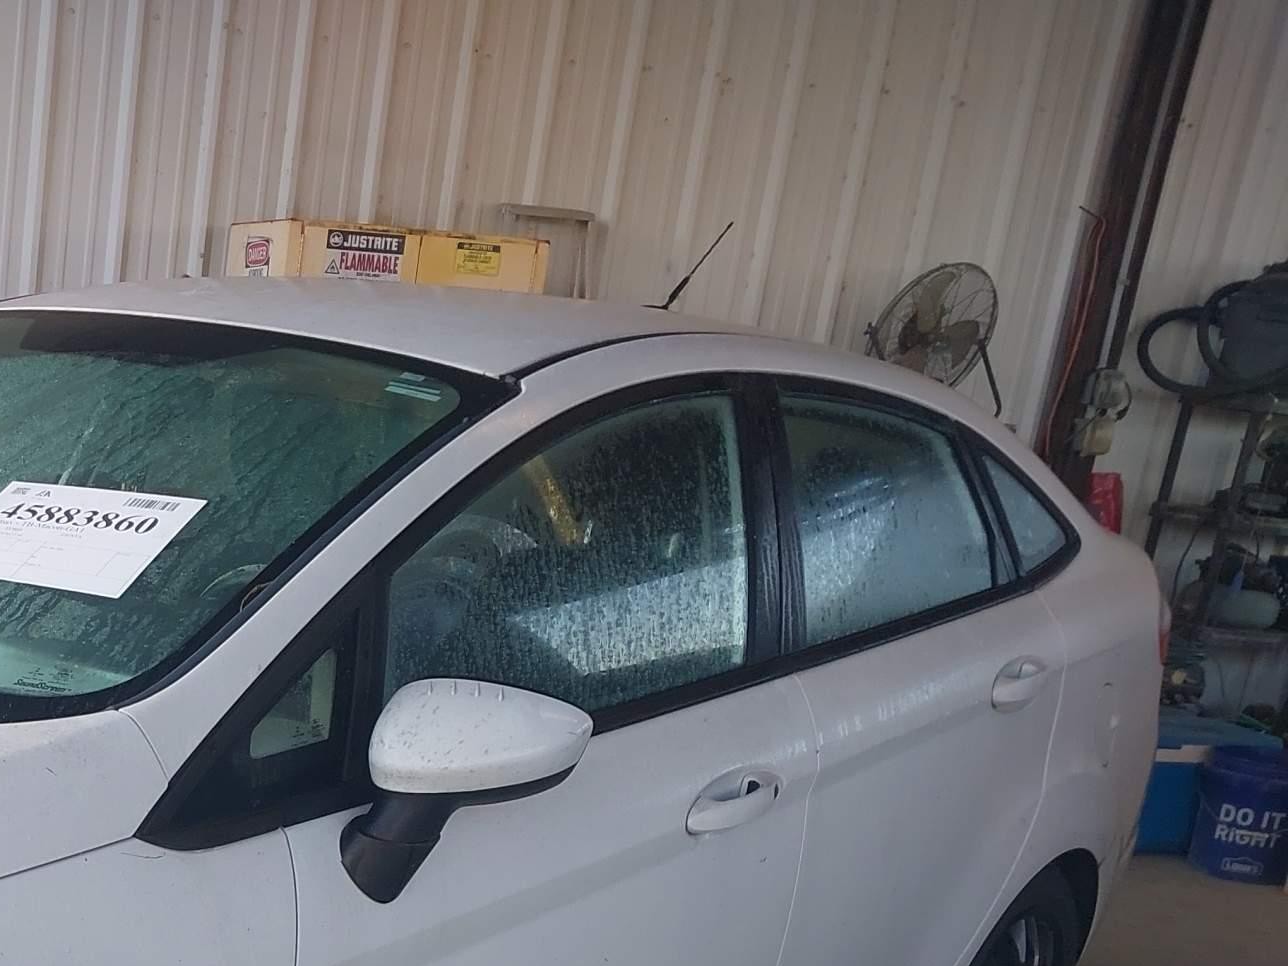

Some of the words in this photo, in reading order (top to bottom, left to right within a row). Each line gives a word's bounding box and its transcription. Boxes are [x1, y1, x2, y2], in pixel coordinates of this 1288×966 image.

[343, 234, 400, 251] JUSTRITE
[339, 252, 400, 275] FLAMMABLE
[1, 502, 160, 535] 45883860
[1219, 803, 1255, 826] DO
[1260, 811, 1287, 831] IT
[1214, 824, 1281, 848] RIGHT
